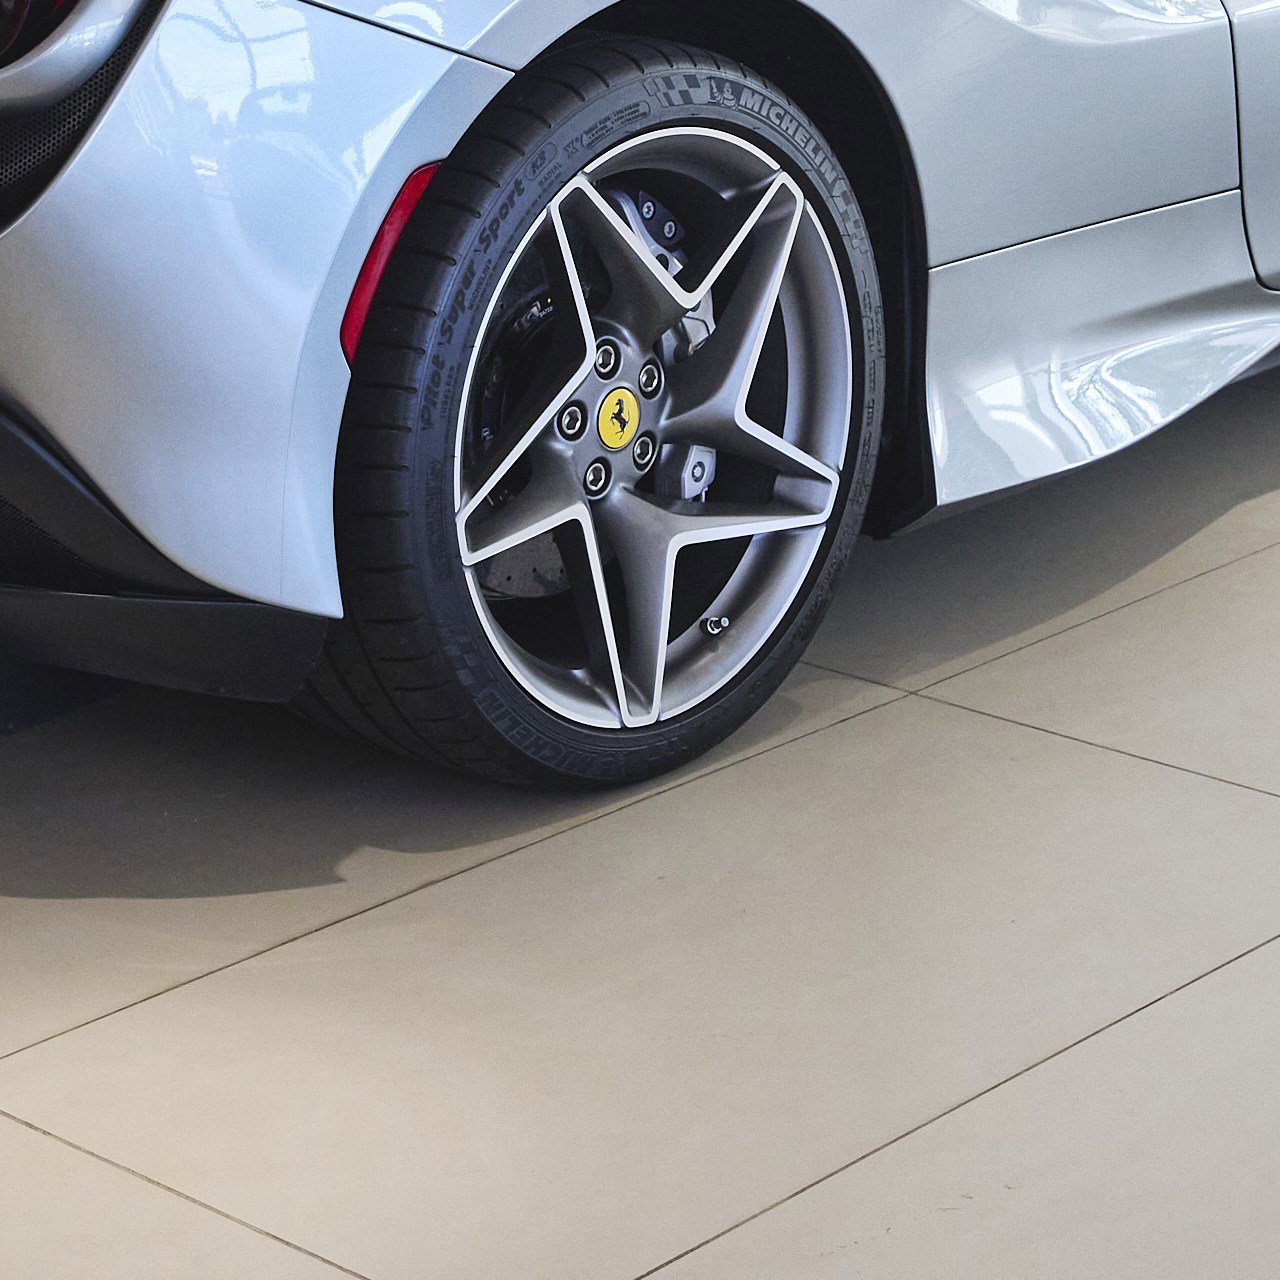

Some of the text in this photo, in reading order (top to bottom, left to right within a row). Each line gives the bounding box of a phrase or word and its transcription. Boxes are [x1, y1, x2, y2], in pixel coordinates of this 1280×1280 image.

[538, 162, 563, 188] RADIAL
[738, 88, 838, 185] MICHELIN
[420, 353, 447, 430] Pilot
[439, 258, 477, 345] Super
[478, 178, 526, 255] Sport
